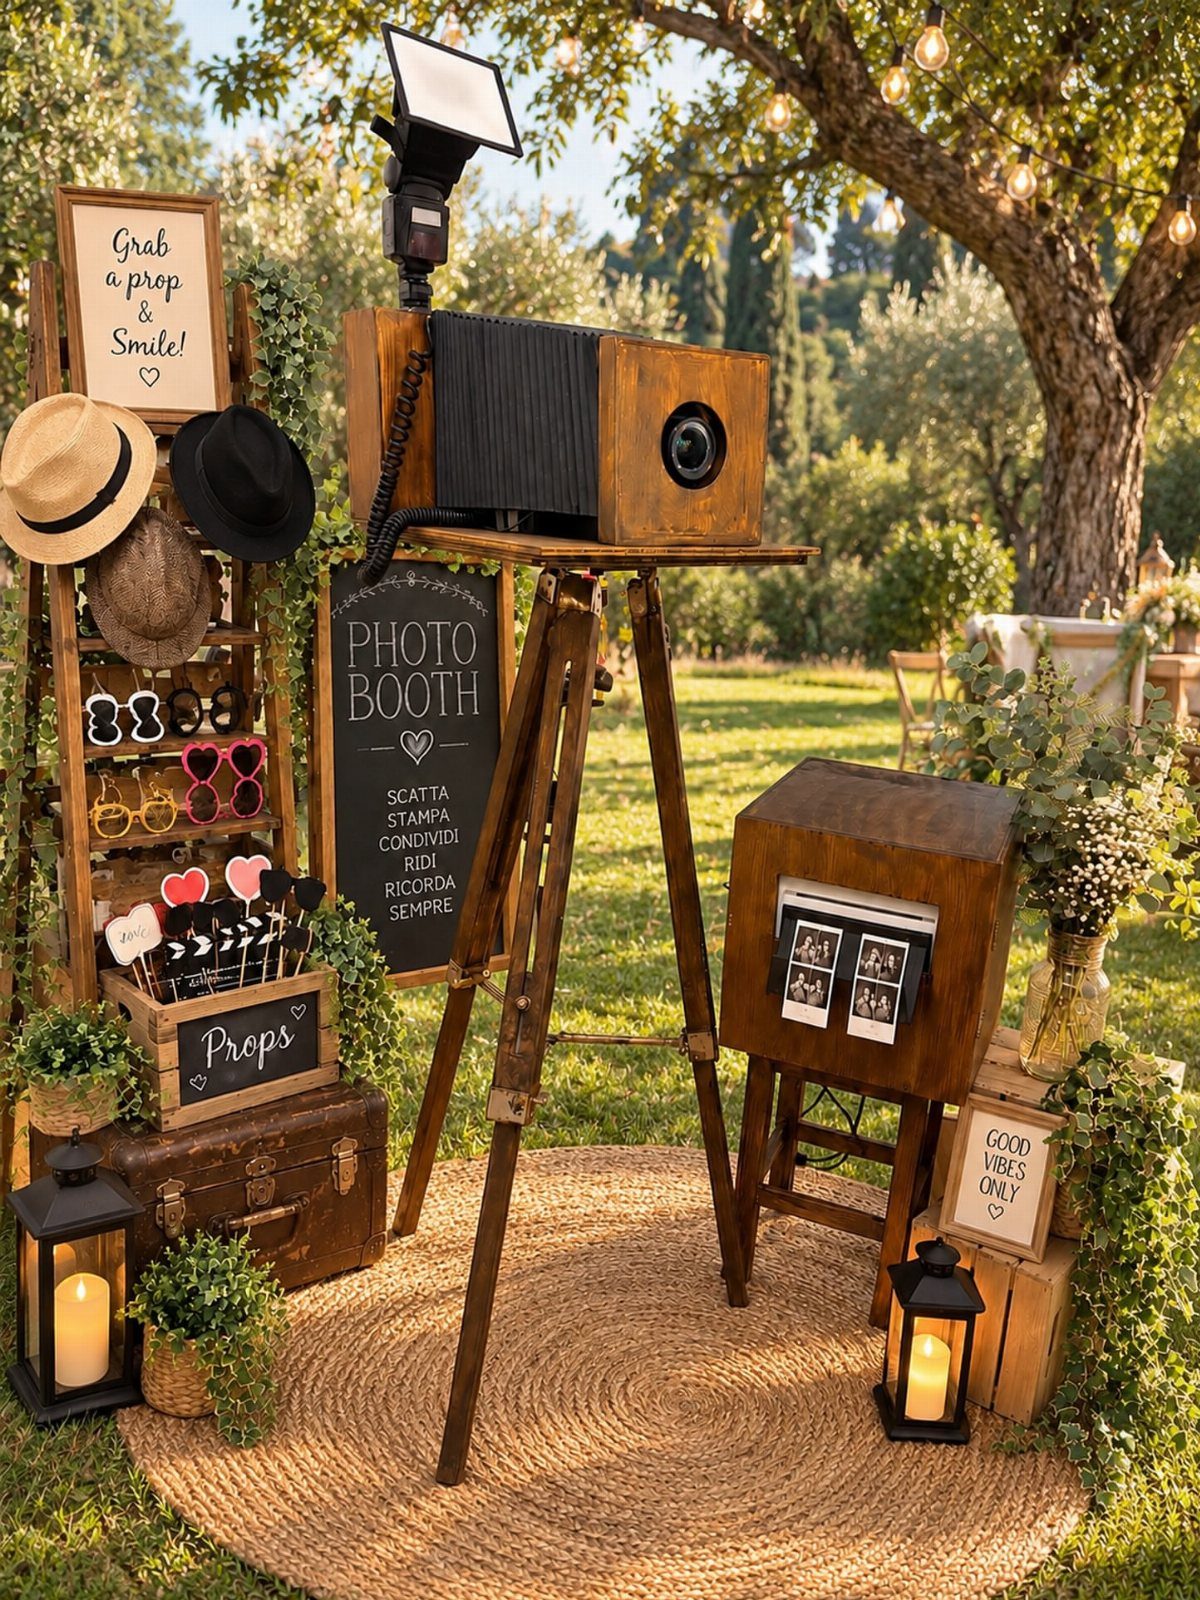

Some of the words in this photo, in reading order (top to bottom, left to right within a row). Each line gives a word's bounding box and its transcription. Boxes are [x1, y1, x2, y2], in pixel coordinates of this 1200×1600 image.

[112, 227, 170, 264] Grab
[106, 271, 122, 287] a
[126, 270, 183, 303] prop
[138, 300, 154, 323] &
[111, 327, 186, 357] Smile!
[347, 621, 477, 668] PHOTO
[348, 670, 480, 721] BOOTH
[387, 785, 450, 806] SCATTA
[387, 807, 451, 829] STAMPA
[378, 828, 460, 852] CONDIVIDI
[404, 852, 437, 872] RIDI
[384, 874, 457, 899] RICORDA
[389, 896, 454, 922] SEMPRE
[201, 1024, 295, 1070] Props
[986, 1128, 1031, 1157] GOOD
[984, 1151, 1027, 1181] VIBES
[979, 1175, 1021, 1203] ONLY
